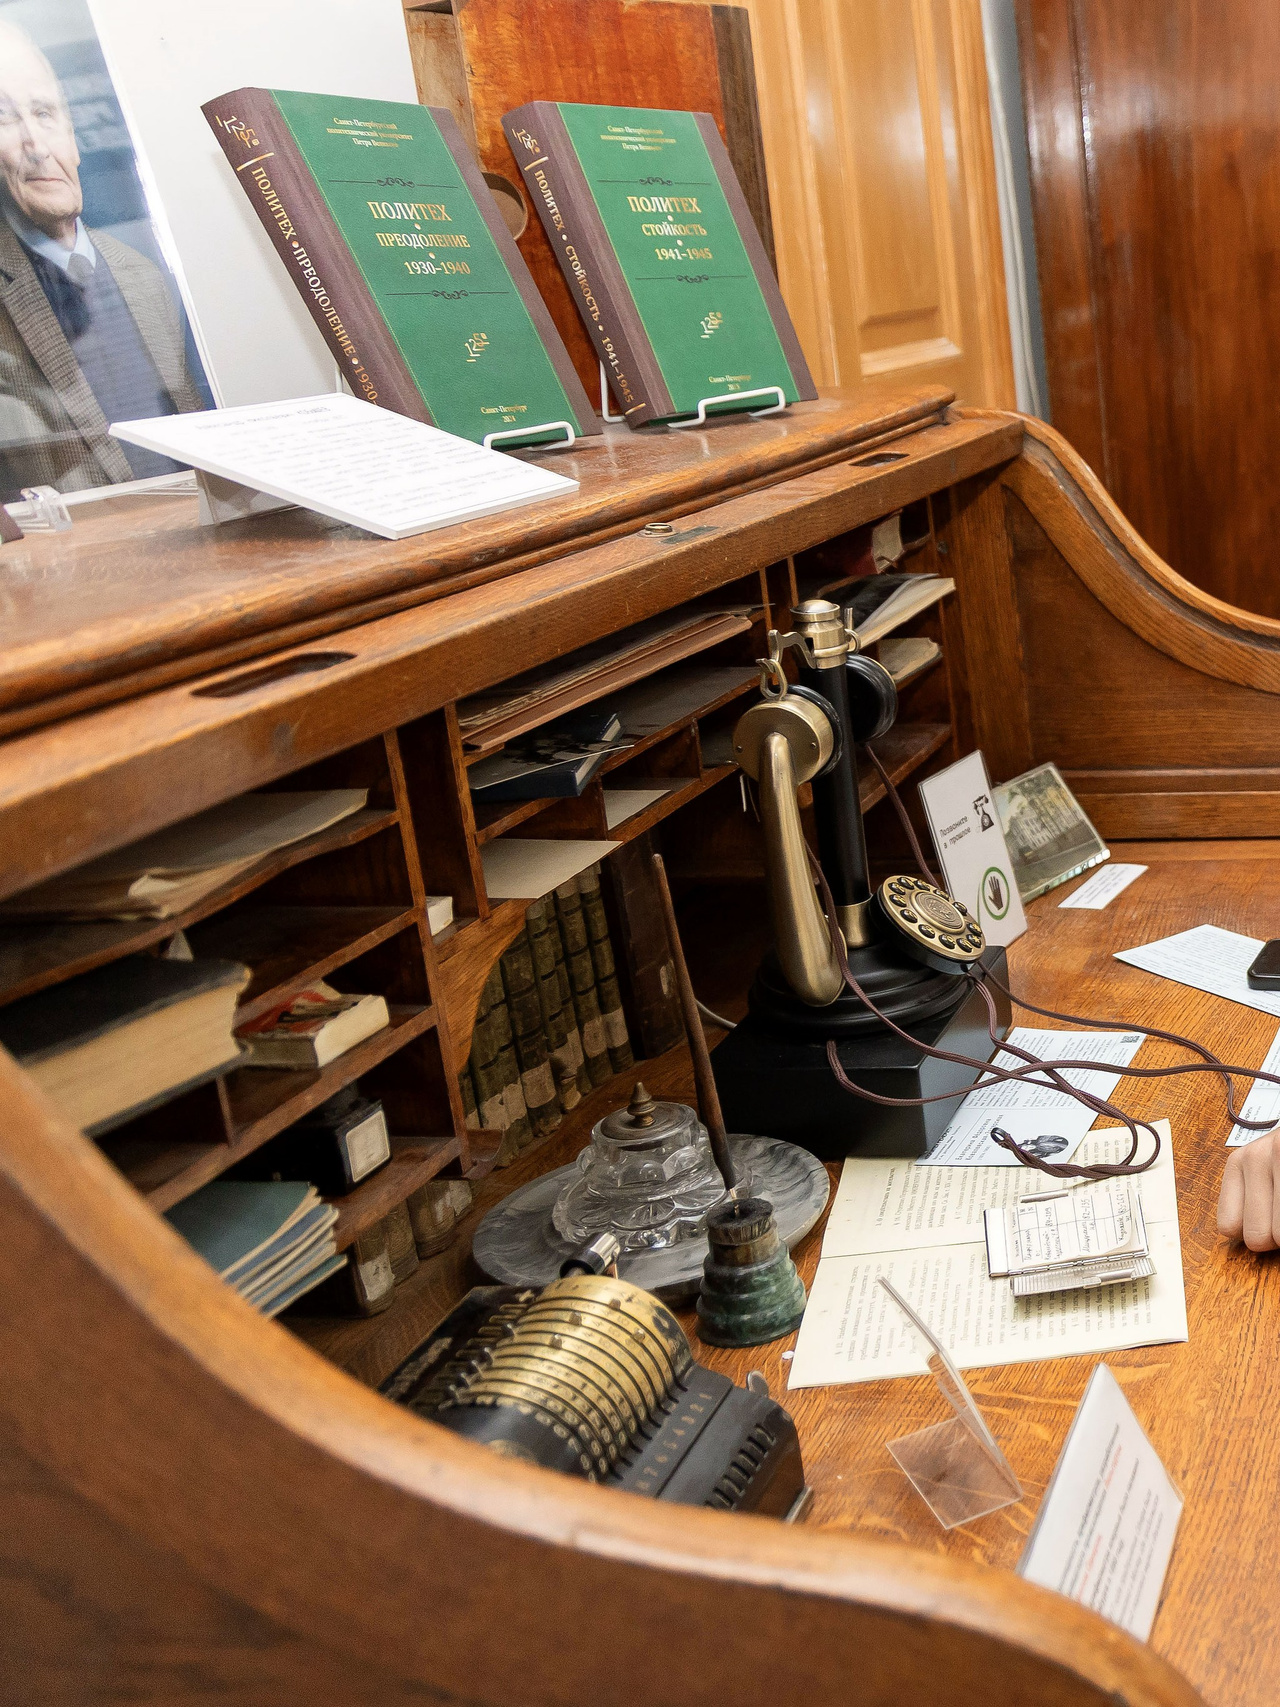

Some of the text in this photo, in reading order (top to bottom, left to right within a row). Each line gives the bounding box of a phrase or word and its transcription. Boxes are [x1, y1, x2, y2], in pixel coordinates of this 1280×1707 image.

[367, 201, 452, 222] ПОЛИТЕХ
[626, 196, 701, 214] ПОЛИТЕХ
[641, 223, 707, 236] СТОЙКОСТЬ
[375, 232, 471, 249] ПРЕОДОЛЕНИЕ
[535, 170, 565, 232] ПОЛИТЕХ
[565, 245, 600, 321] СТОЙКОСТЬ
[251, 166, 298, 242] ПОЛИТЕХ
[293, 246, 357, 358] ПРЕОДОЛЕНИЕ
[940, 815, 968, 838] Позвоните
[950, 826, 971, 845] прошлое
